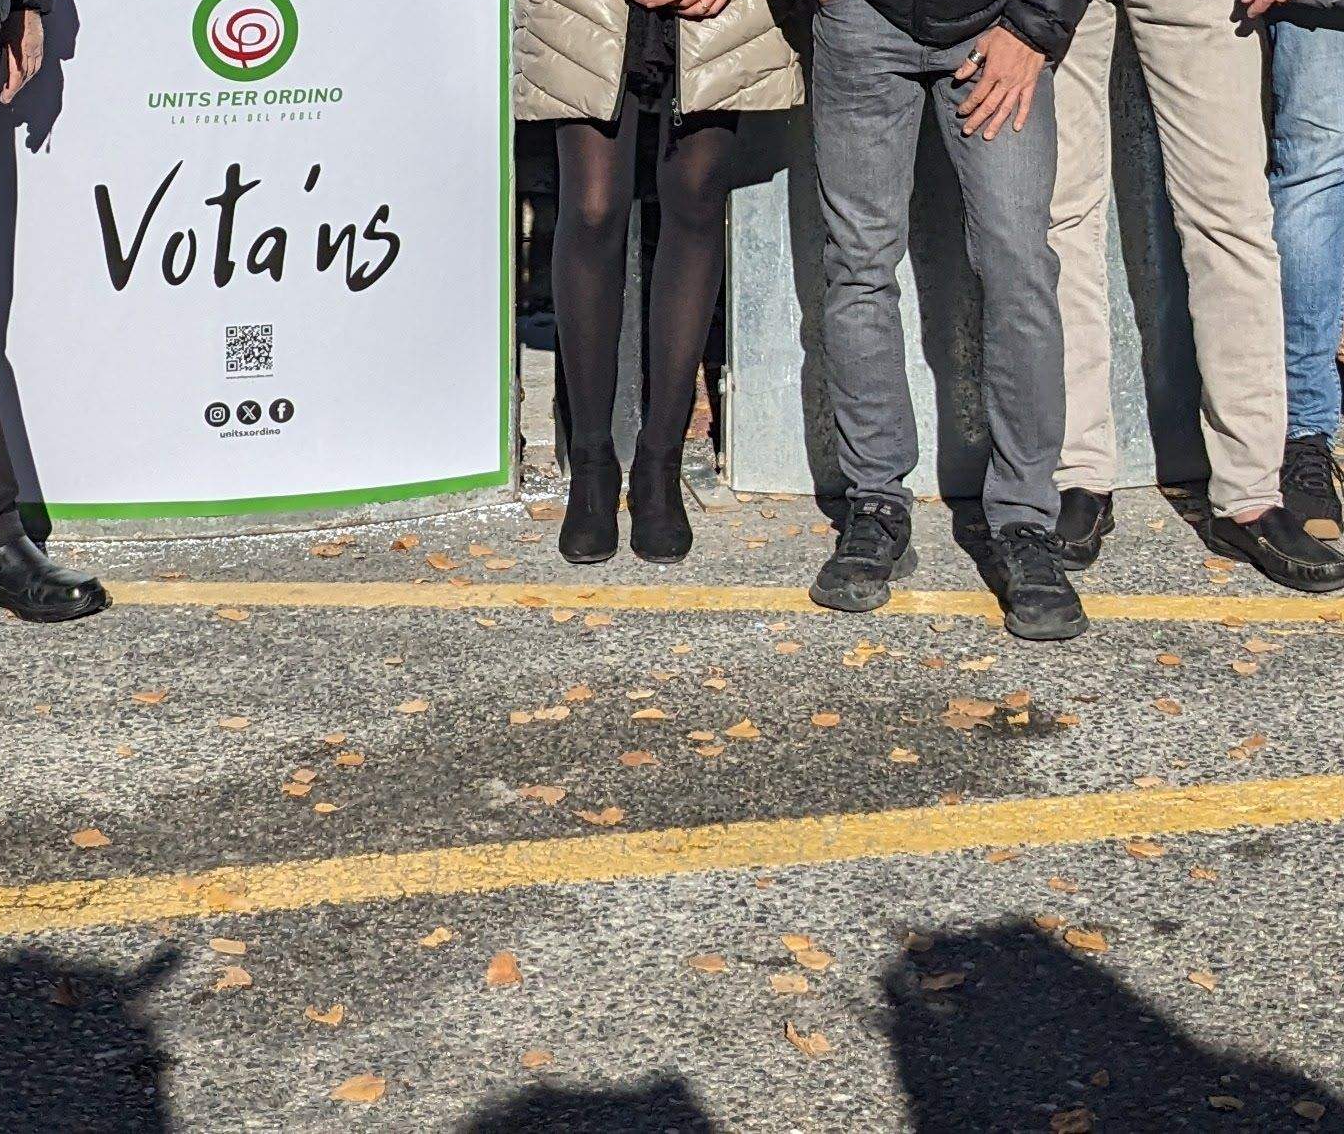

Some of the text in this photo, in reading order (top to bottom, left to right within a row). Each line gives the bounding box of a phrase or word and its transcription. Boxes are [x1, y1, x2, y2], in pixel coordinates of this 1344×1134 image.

[147, 87, 344, 108] UNITS PER ORDINO
[171, 110, 322, 125] LA FORÇA DEL POBLE
[219, 427, 281, 439] unitsxordino
